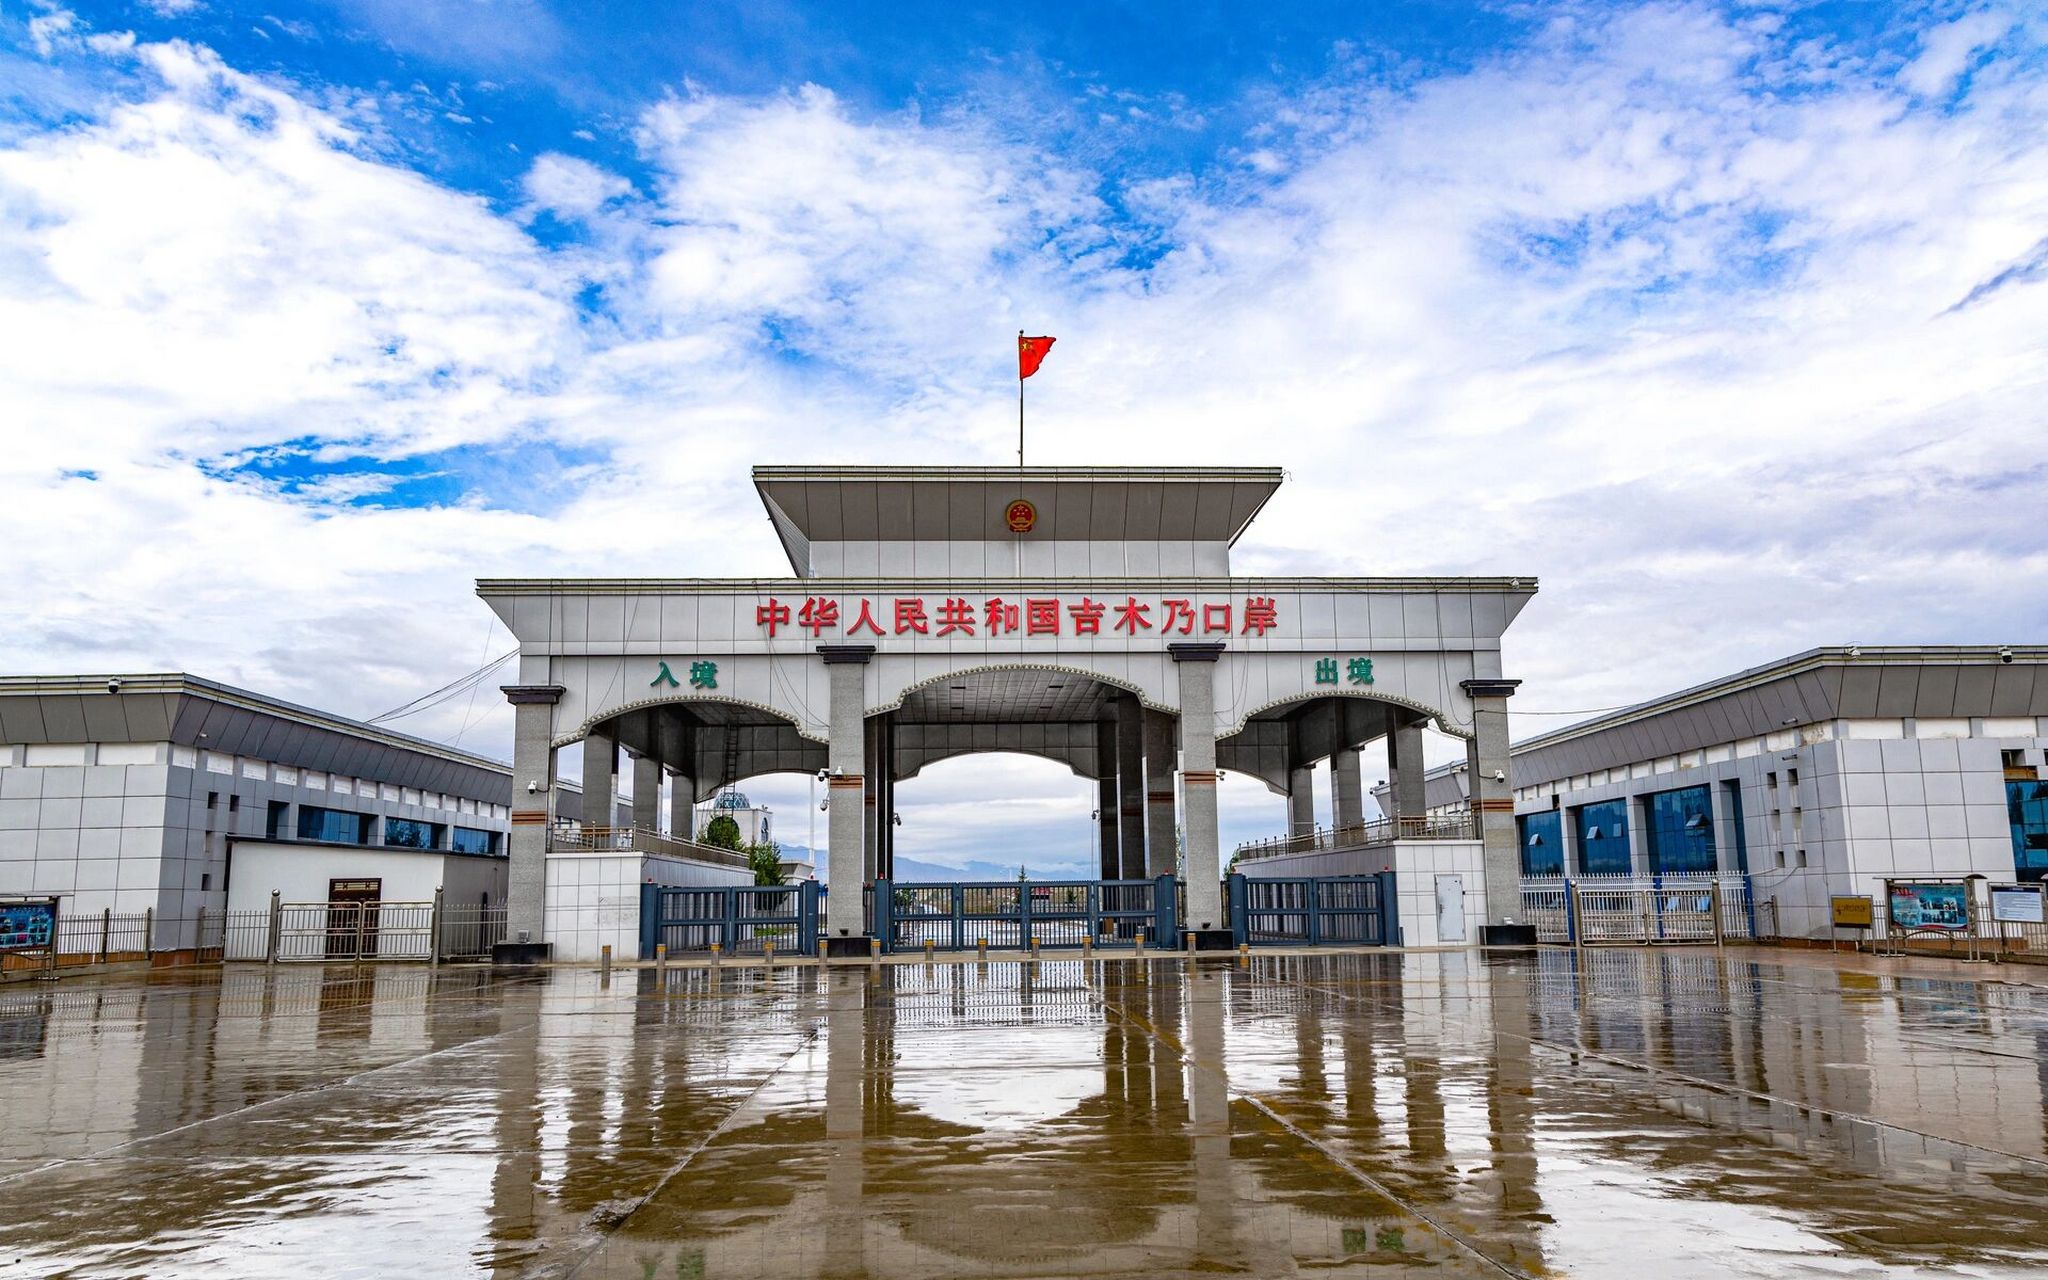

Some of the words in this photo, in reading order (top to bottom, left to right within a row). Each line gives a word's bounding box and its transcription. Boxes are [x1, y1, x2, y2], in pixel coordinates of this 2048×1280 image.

[756, 597, 1277, 637] 中华人民共和国吉木乃口岸
[650, 661, 718, 689] 入境
[1315, 657, 1375, 685] 出境
